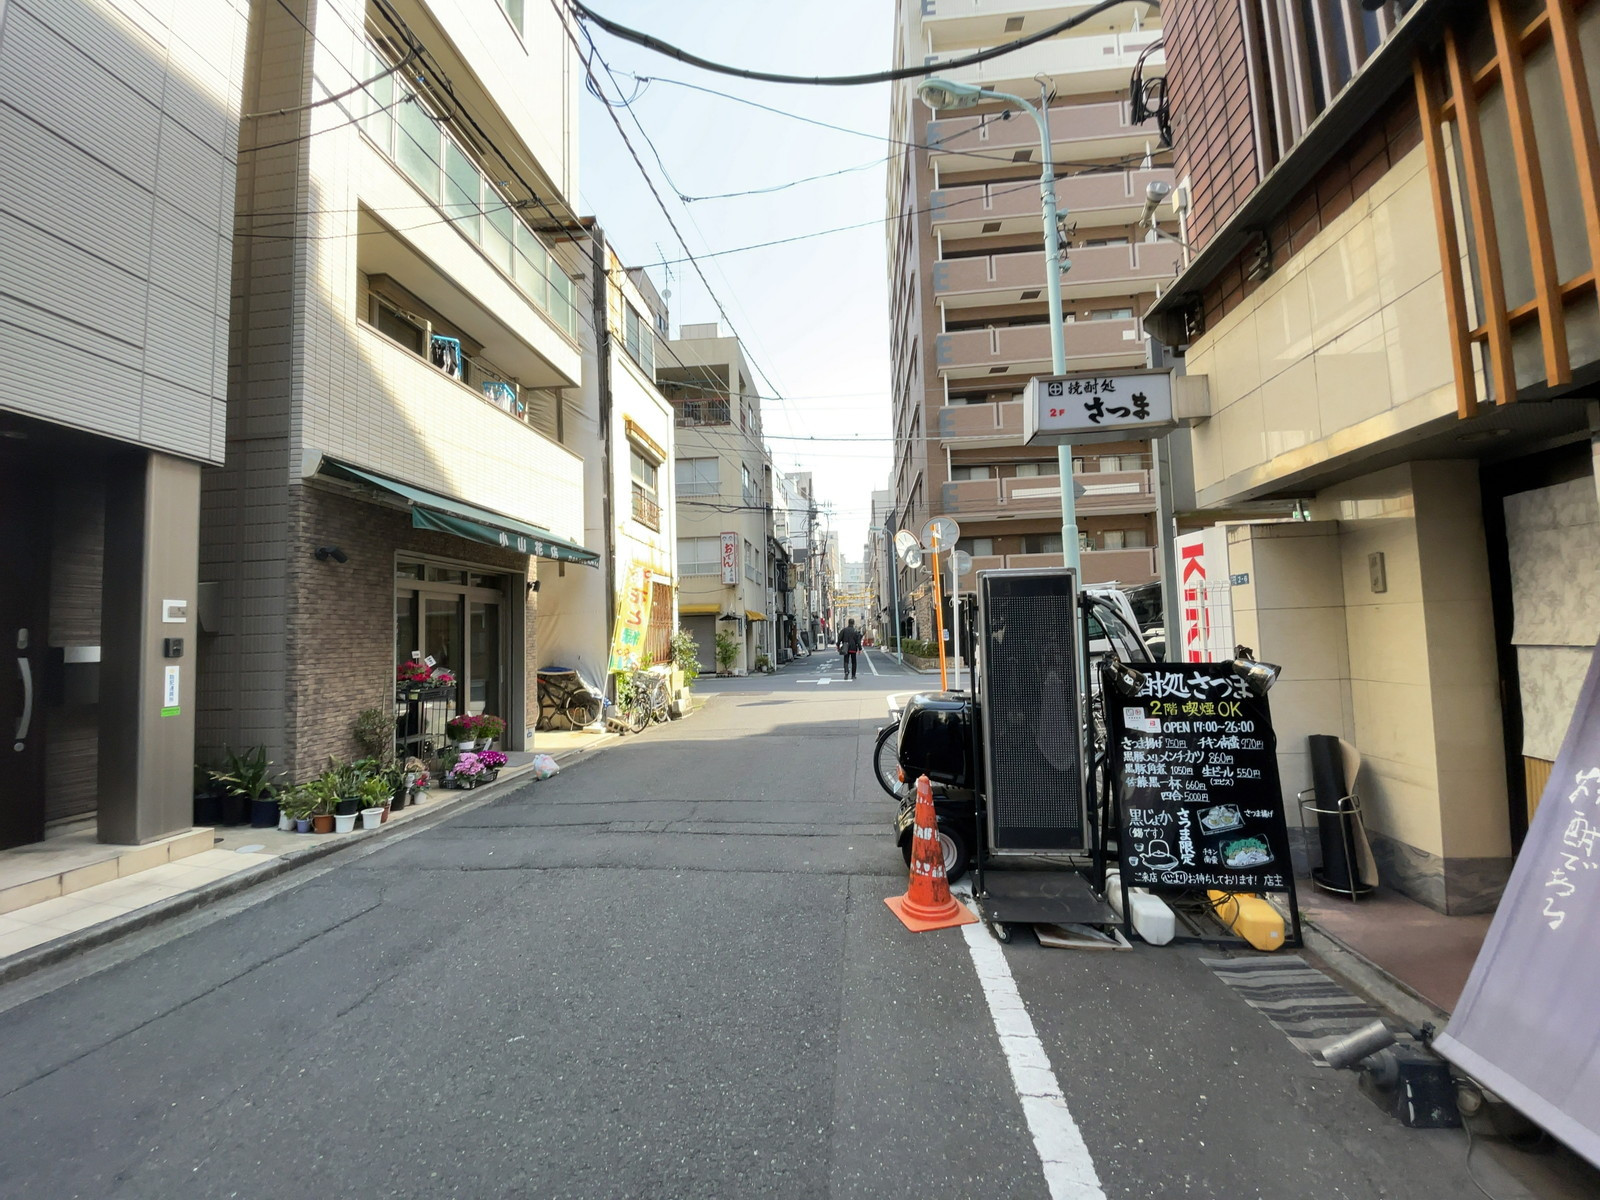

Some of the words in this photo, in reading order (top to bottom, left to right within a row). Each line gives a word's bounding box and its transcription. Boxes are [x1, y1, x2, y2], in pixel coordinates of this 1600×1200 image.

[1068, 379, 1116, 395] 焼酎処
[1049, 408, 1065, 418] 2F
[1083, 391, 1151, 424] さつま
[1134, 671, 1254, 699] 酎処さつま
[1217, 701, 1243, 717] OK
[1163, 721, 1190, 733] OPEN
[1121, 736, 1163, 750] さつま揚げ
[1197, 735, 1240, 749] チキン南蛮
[1202, 765, 1234, 777] 生ビール
[1128, 808, 1174, 827] 黒じょか
[1176, 807, 1196, 867] さつま限定
